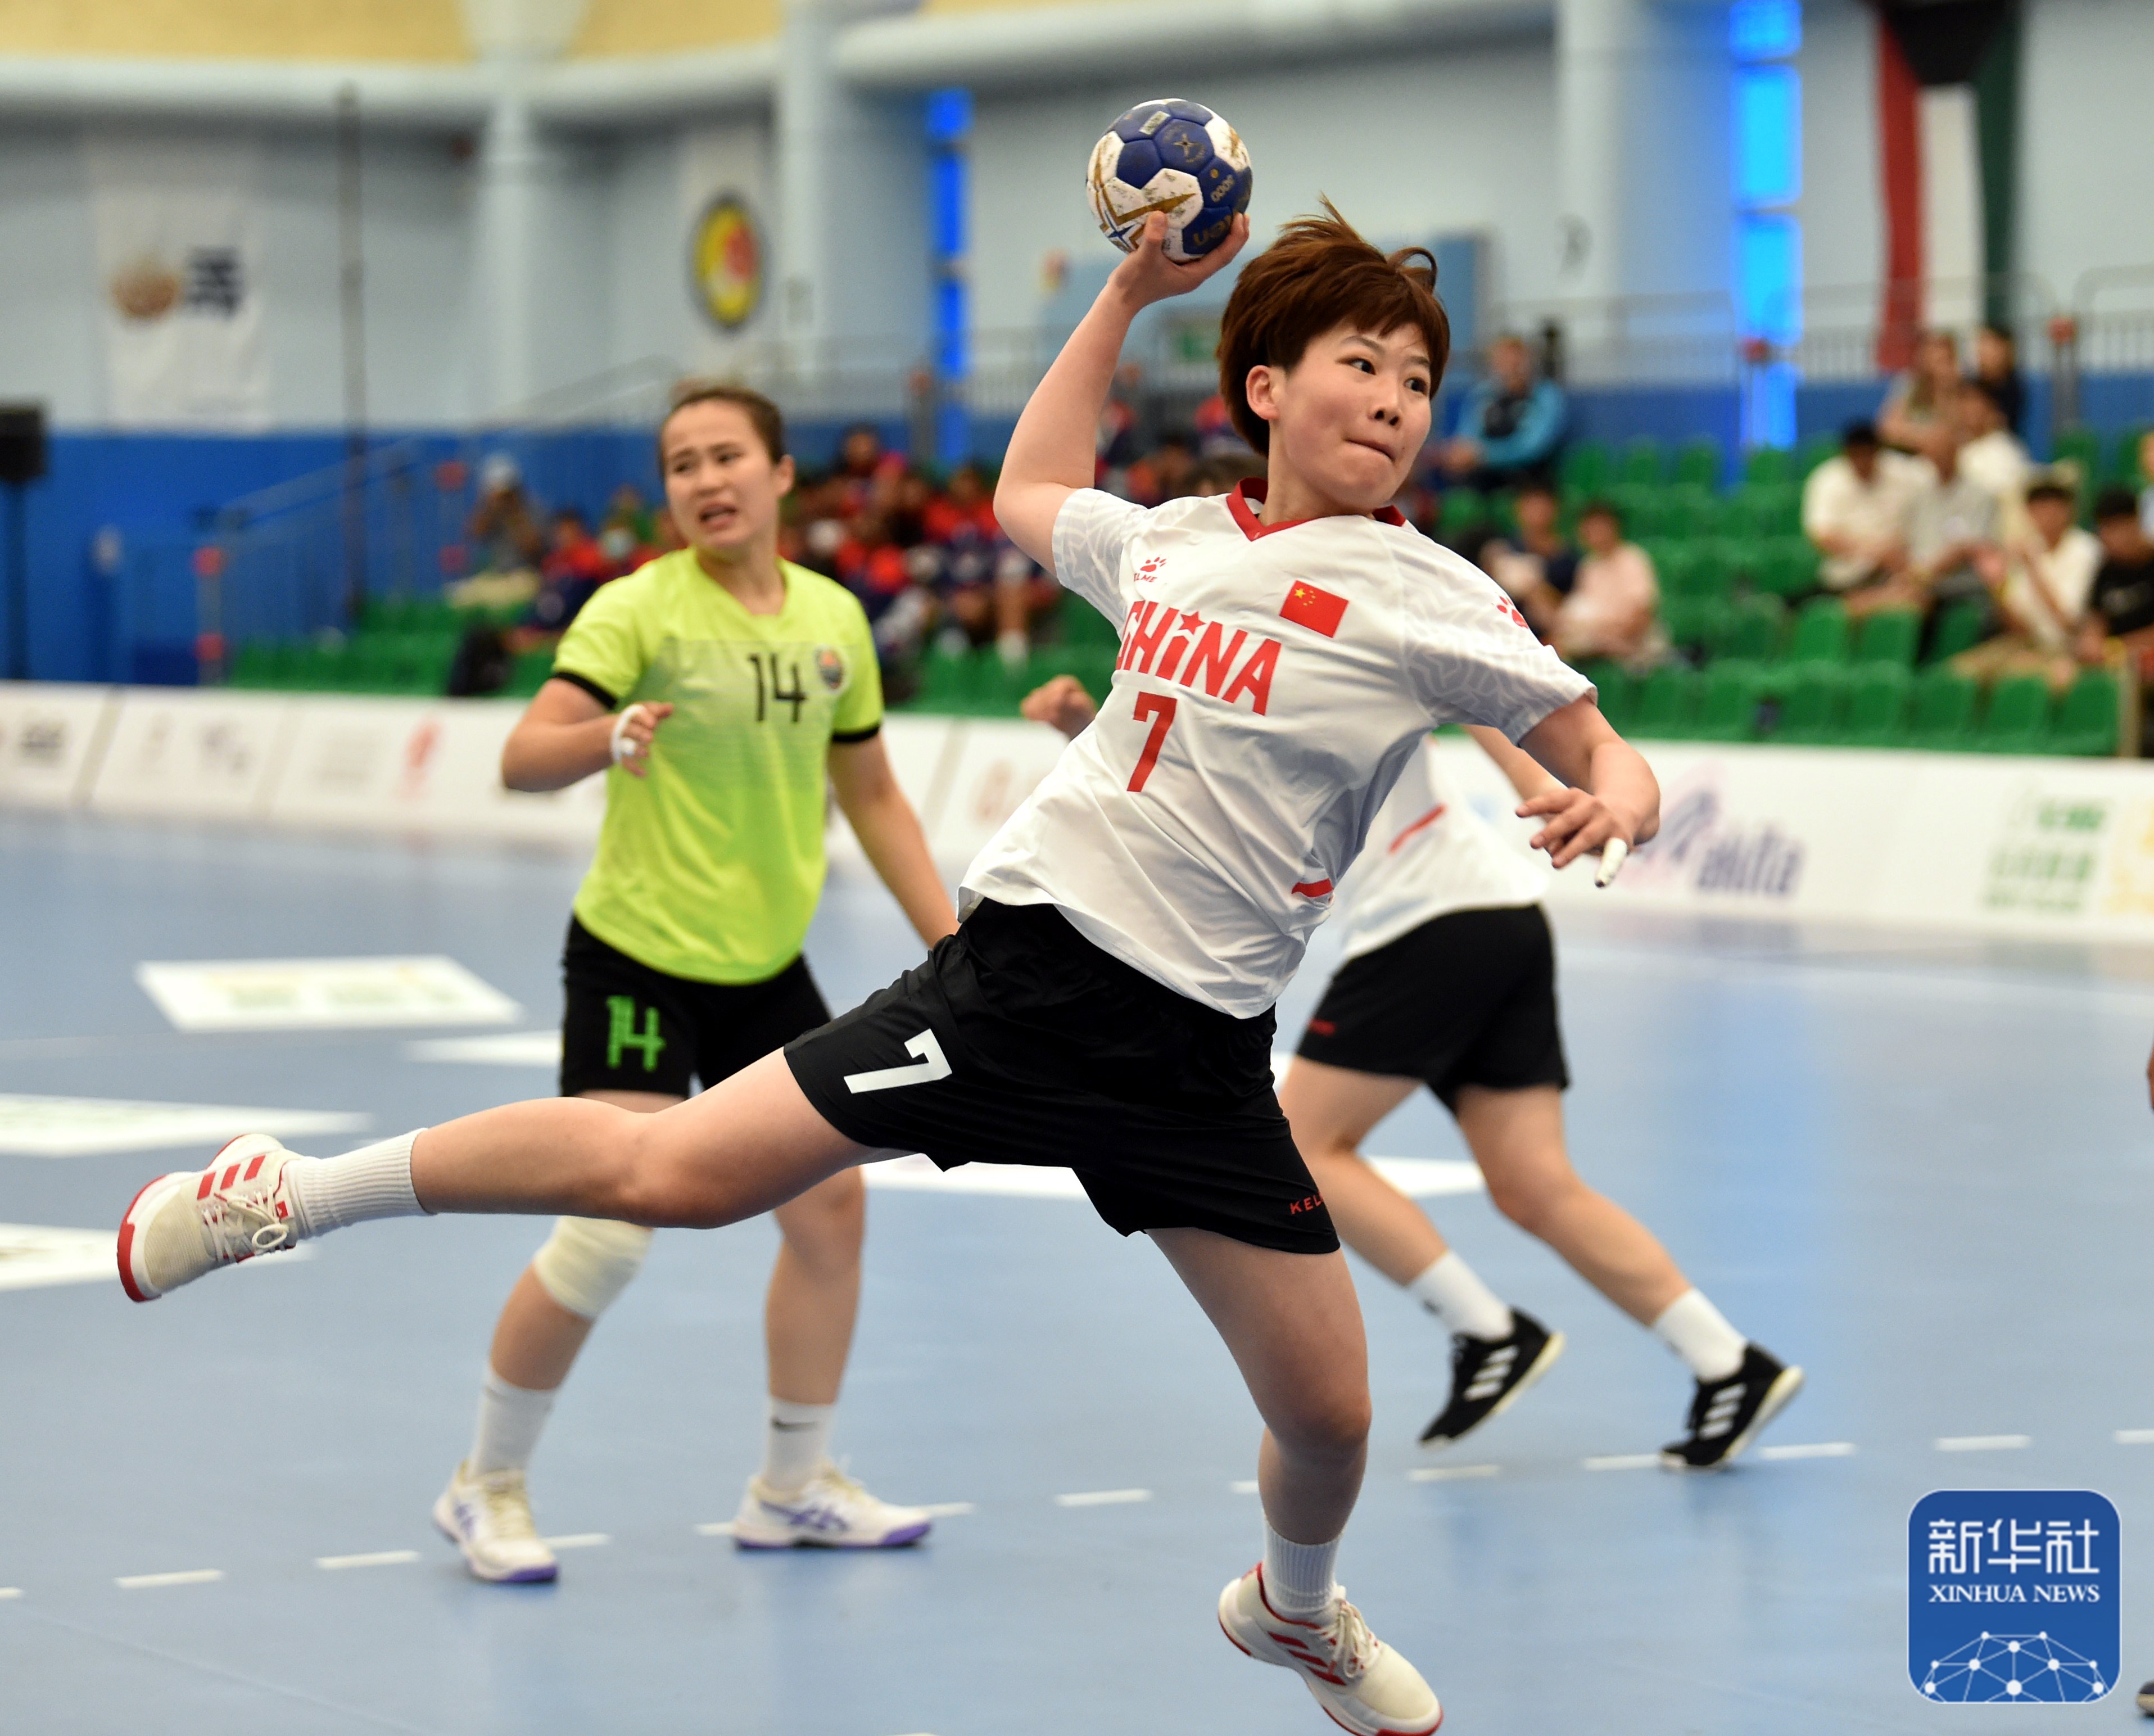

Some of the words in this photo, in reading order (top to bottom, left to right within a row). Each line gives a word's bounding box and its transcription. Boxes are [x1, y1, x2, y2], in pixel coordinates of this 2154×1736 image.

[748, 652, 808, 723] 14
[1126, 691, 1178, 793] 7
[605, 994, 667, 1072] 14
[843, 1028, 953, 1094] 7
